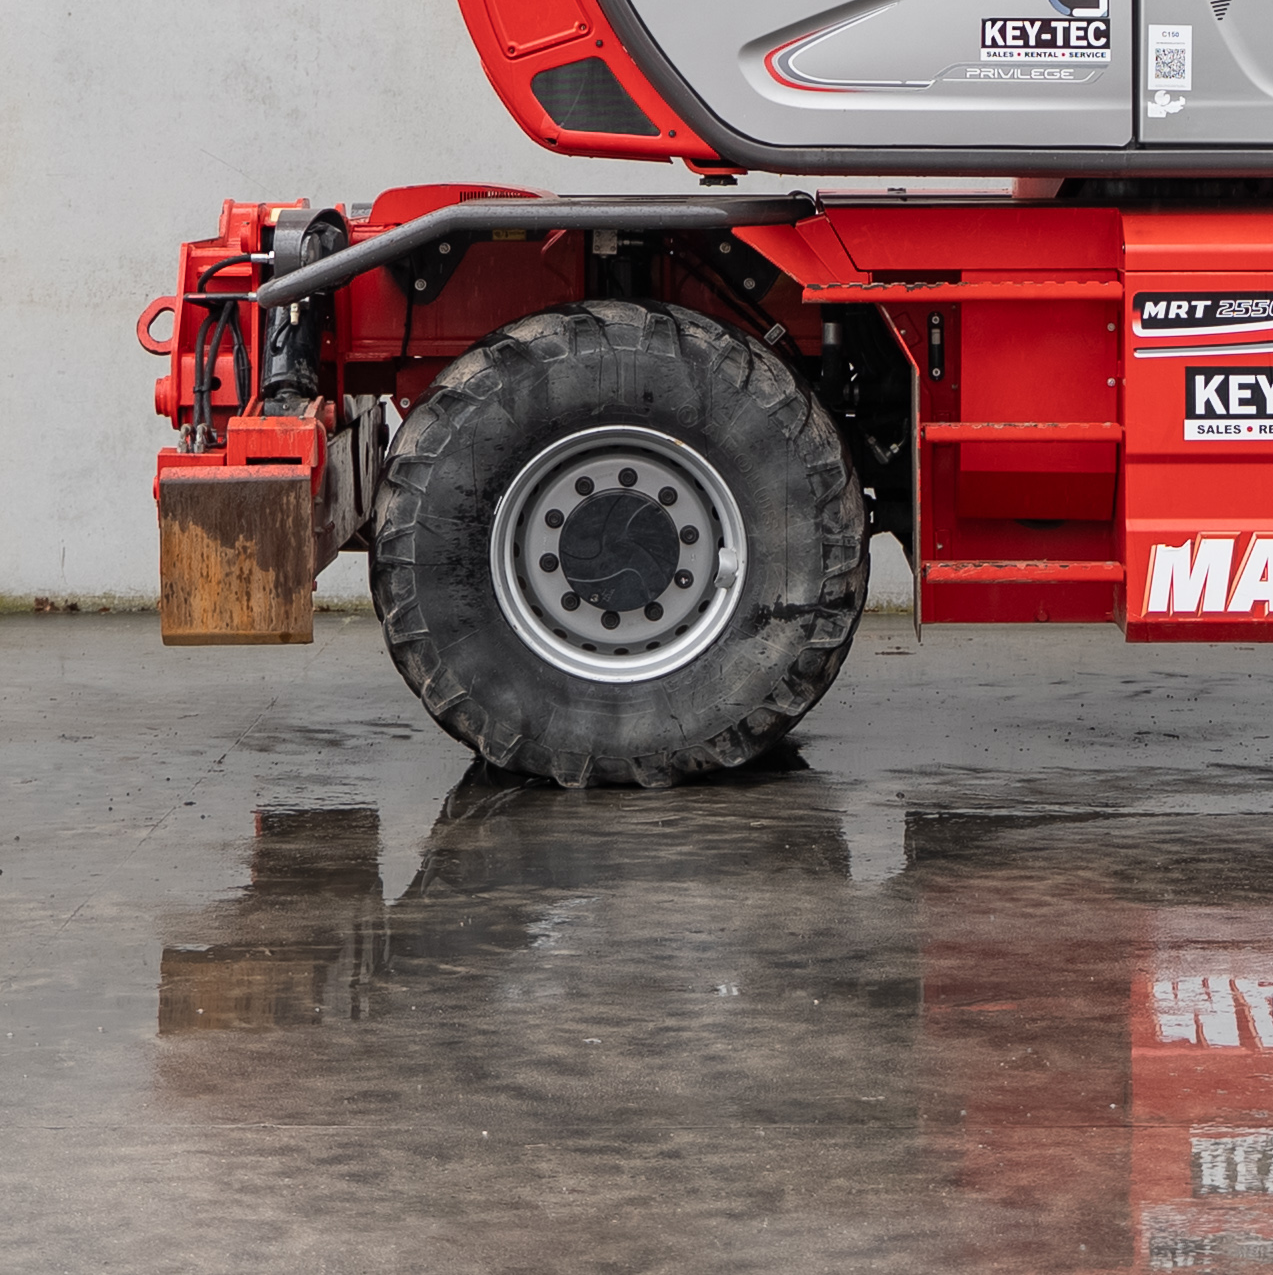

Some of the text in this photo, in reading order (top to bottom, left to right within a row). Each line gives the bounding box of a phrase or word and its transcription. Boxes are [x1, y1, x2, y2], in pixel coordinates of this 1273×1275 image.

[984, 20, 1108, 47] KEY-TEC
[966, 68, 1075, 79] PRIVILEGE
[1142, 300, 1212, 319] MRT
[1197, 424, 1242, 435] SALES
